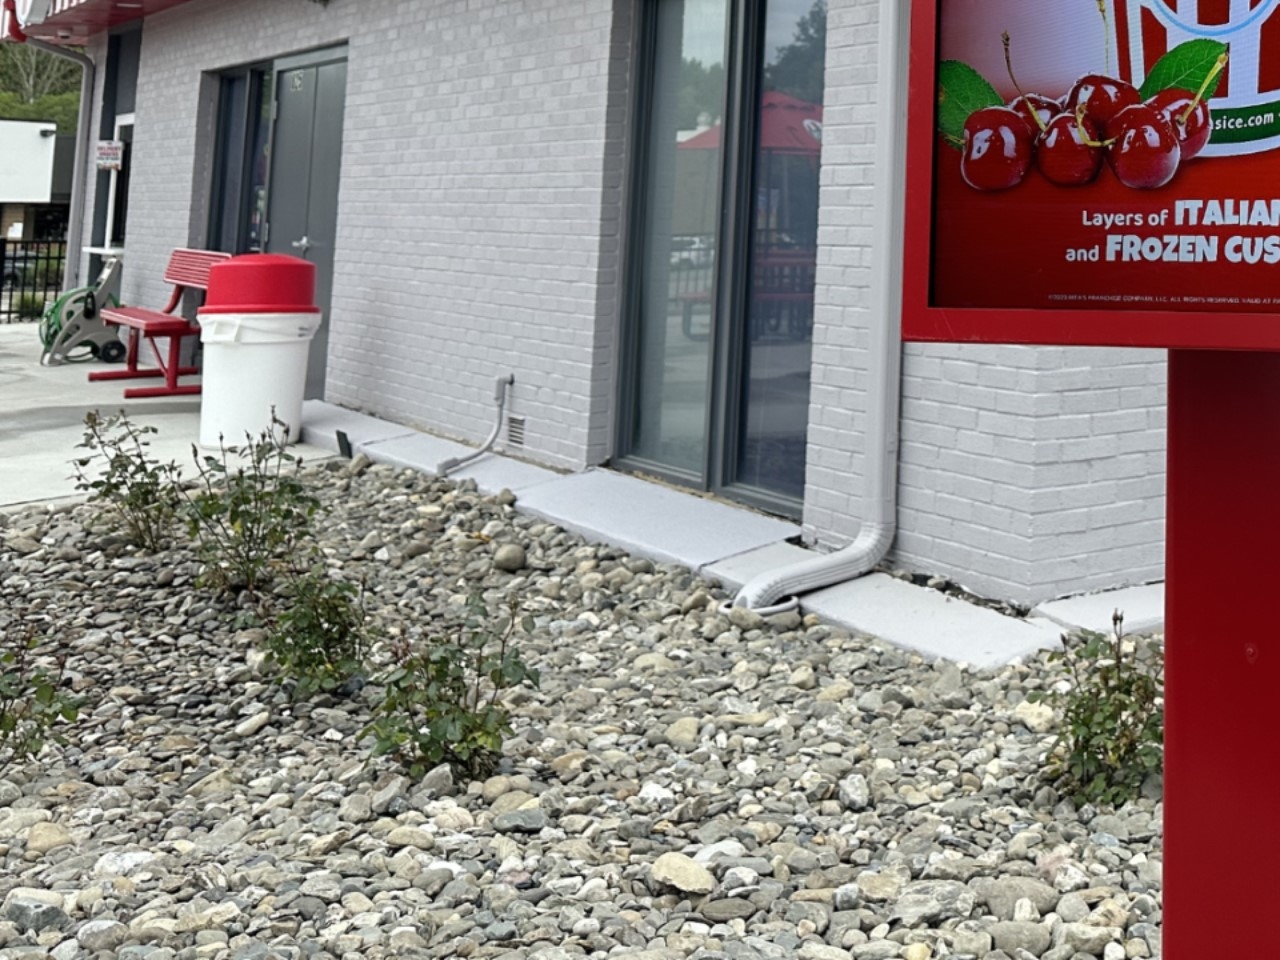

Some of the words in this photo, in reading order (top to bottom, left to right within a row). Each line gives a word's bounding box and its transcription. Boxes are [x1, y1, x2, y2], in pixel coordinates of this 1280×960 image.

[1210, 111, 1274, 131] sice.com
[1082, 209, 1143, 230] Layers
[1147, 208, 1169, 227] of
[1065, 245, 1099, 263] and
[1105, 234, 1219, 263] FROZEN
